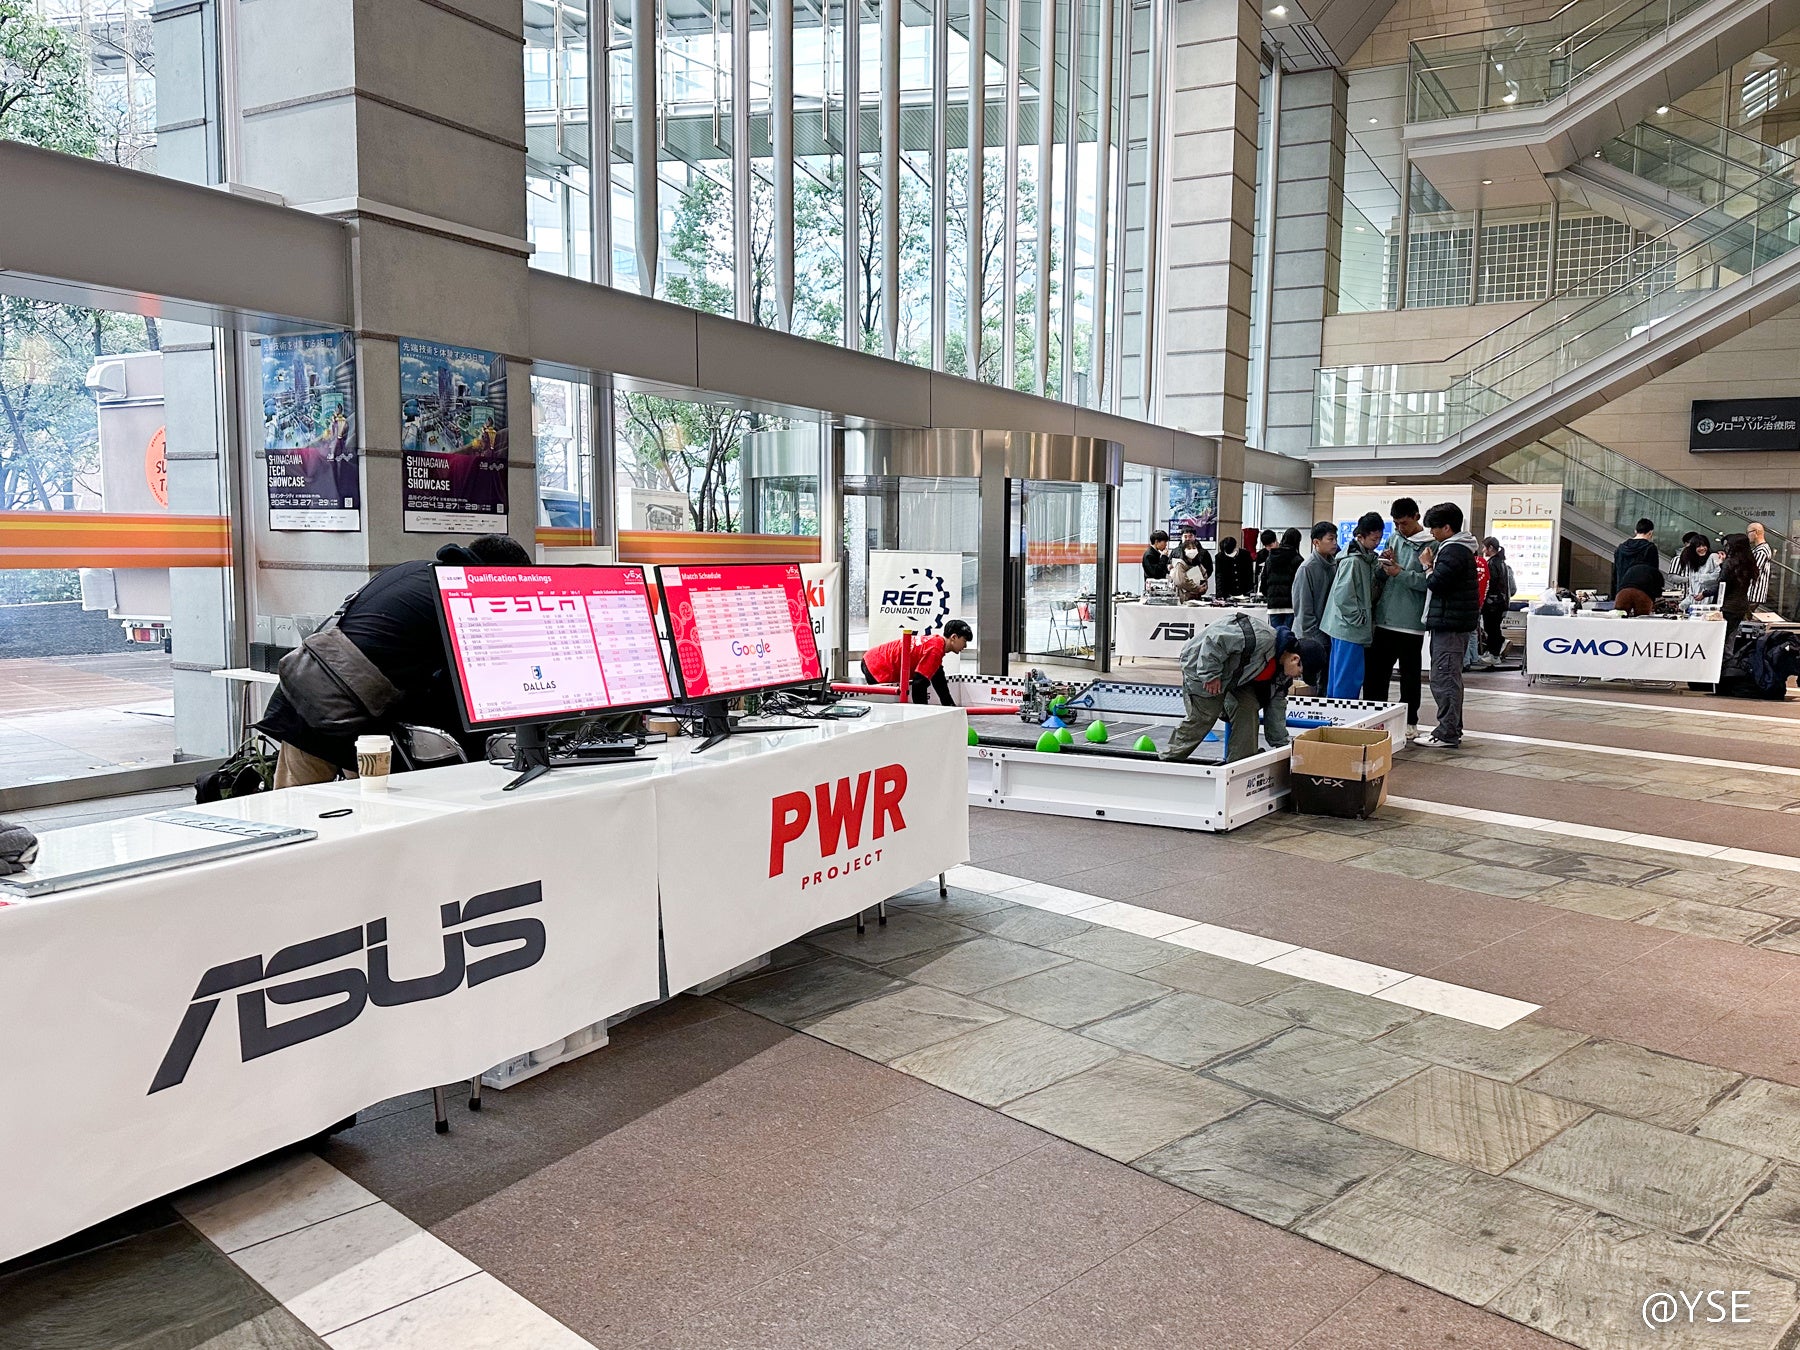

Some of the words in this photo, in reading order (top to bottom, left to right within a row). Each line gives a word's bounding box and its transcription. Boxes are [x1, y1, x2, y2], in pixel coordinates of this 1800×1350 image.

[1715, 420, 1796, 432] グローバル治療院
[268, 454, 303, 465] SHINAGAWA
[406, 455, 450, 469] SHINAGAWA
[268, 466, 286, 476] TECH
[407, 467, 429, 478] TECH
[268, 476, 305, 487] SHOWCASE
[407, 478, 450, 491] SHOWCASE
[1510, 497, 1543, 514] B1F
[623, 570, 643, 579] VEX
[681, 572, 699, 580] Match
[698, 572, 722, 580] Schedule
[785, 566, 799, 575] VEX
[467, 574, 517, 583] Qualification
[518, 574, 552, 584] Rankings
[881, 590, 934, 606] REC
[879, 606, 931, 615] FOUNDATION
[731, 639, 771, 658] Google
[1543, 637, 1629, 657] GMO
[1631, 641, 1707, 660] MEDIA
[523, 680, 557, 692] DALLAS
[1287, 710, 1306, 719] AVC
[1311, 777, 1345, 789] VEX
[768, 763, 908, 879] PWR
[801, 849, 884, 891] PROJECT
[147, 880, 547, 1096] ASUS
